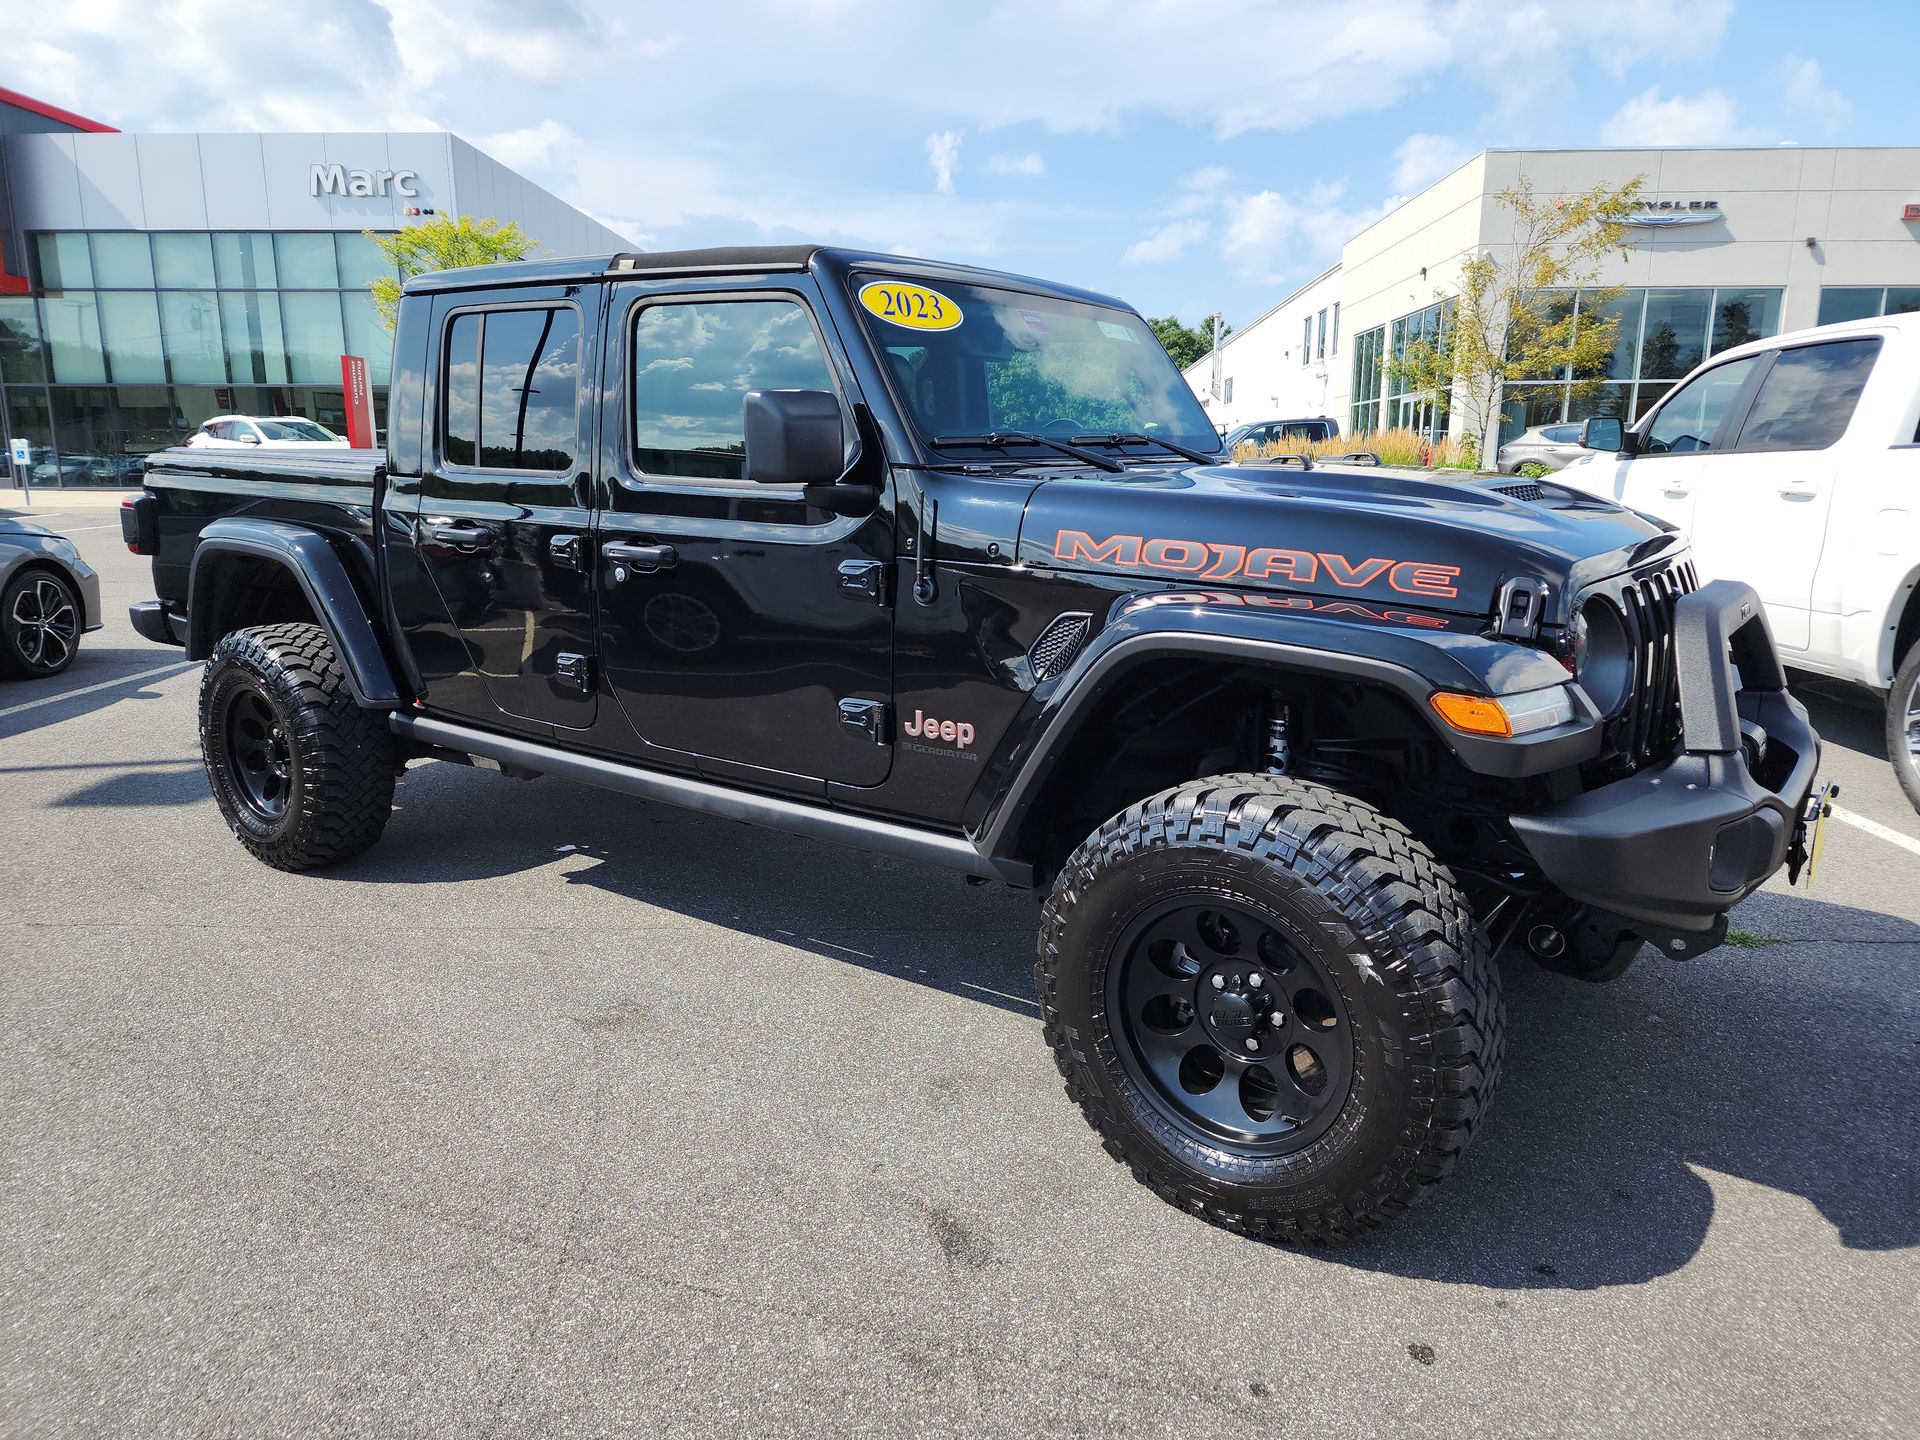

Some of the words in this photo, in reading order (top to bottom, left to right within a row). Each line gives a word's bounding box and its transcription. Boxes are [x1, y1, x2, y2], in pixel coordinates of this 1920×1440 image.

[310, 163, 417, 197] Marc
[1633, 200, 1718, 210] YSLER
[879, 290, 943, 320] 2023
[1054, 529, 1460, 598] MOJAVE
[904, 709, 976, 749] Jeep
[913, 744, 978, 762] GLADIATOR
